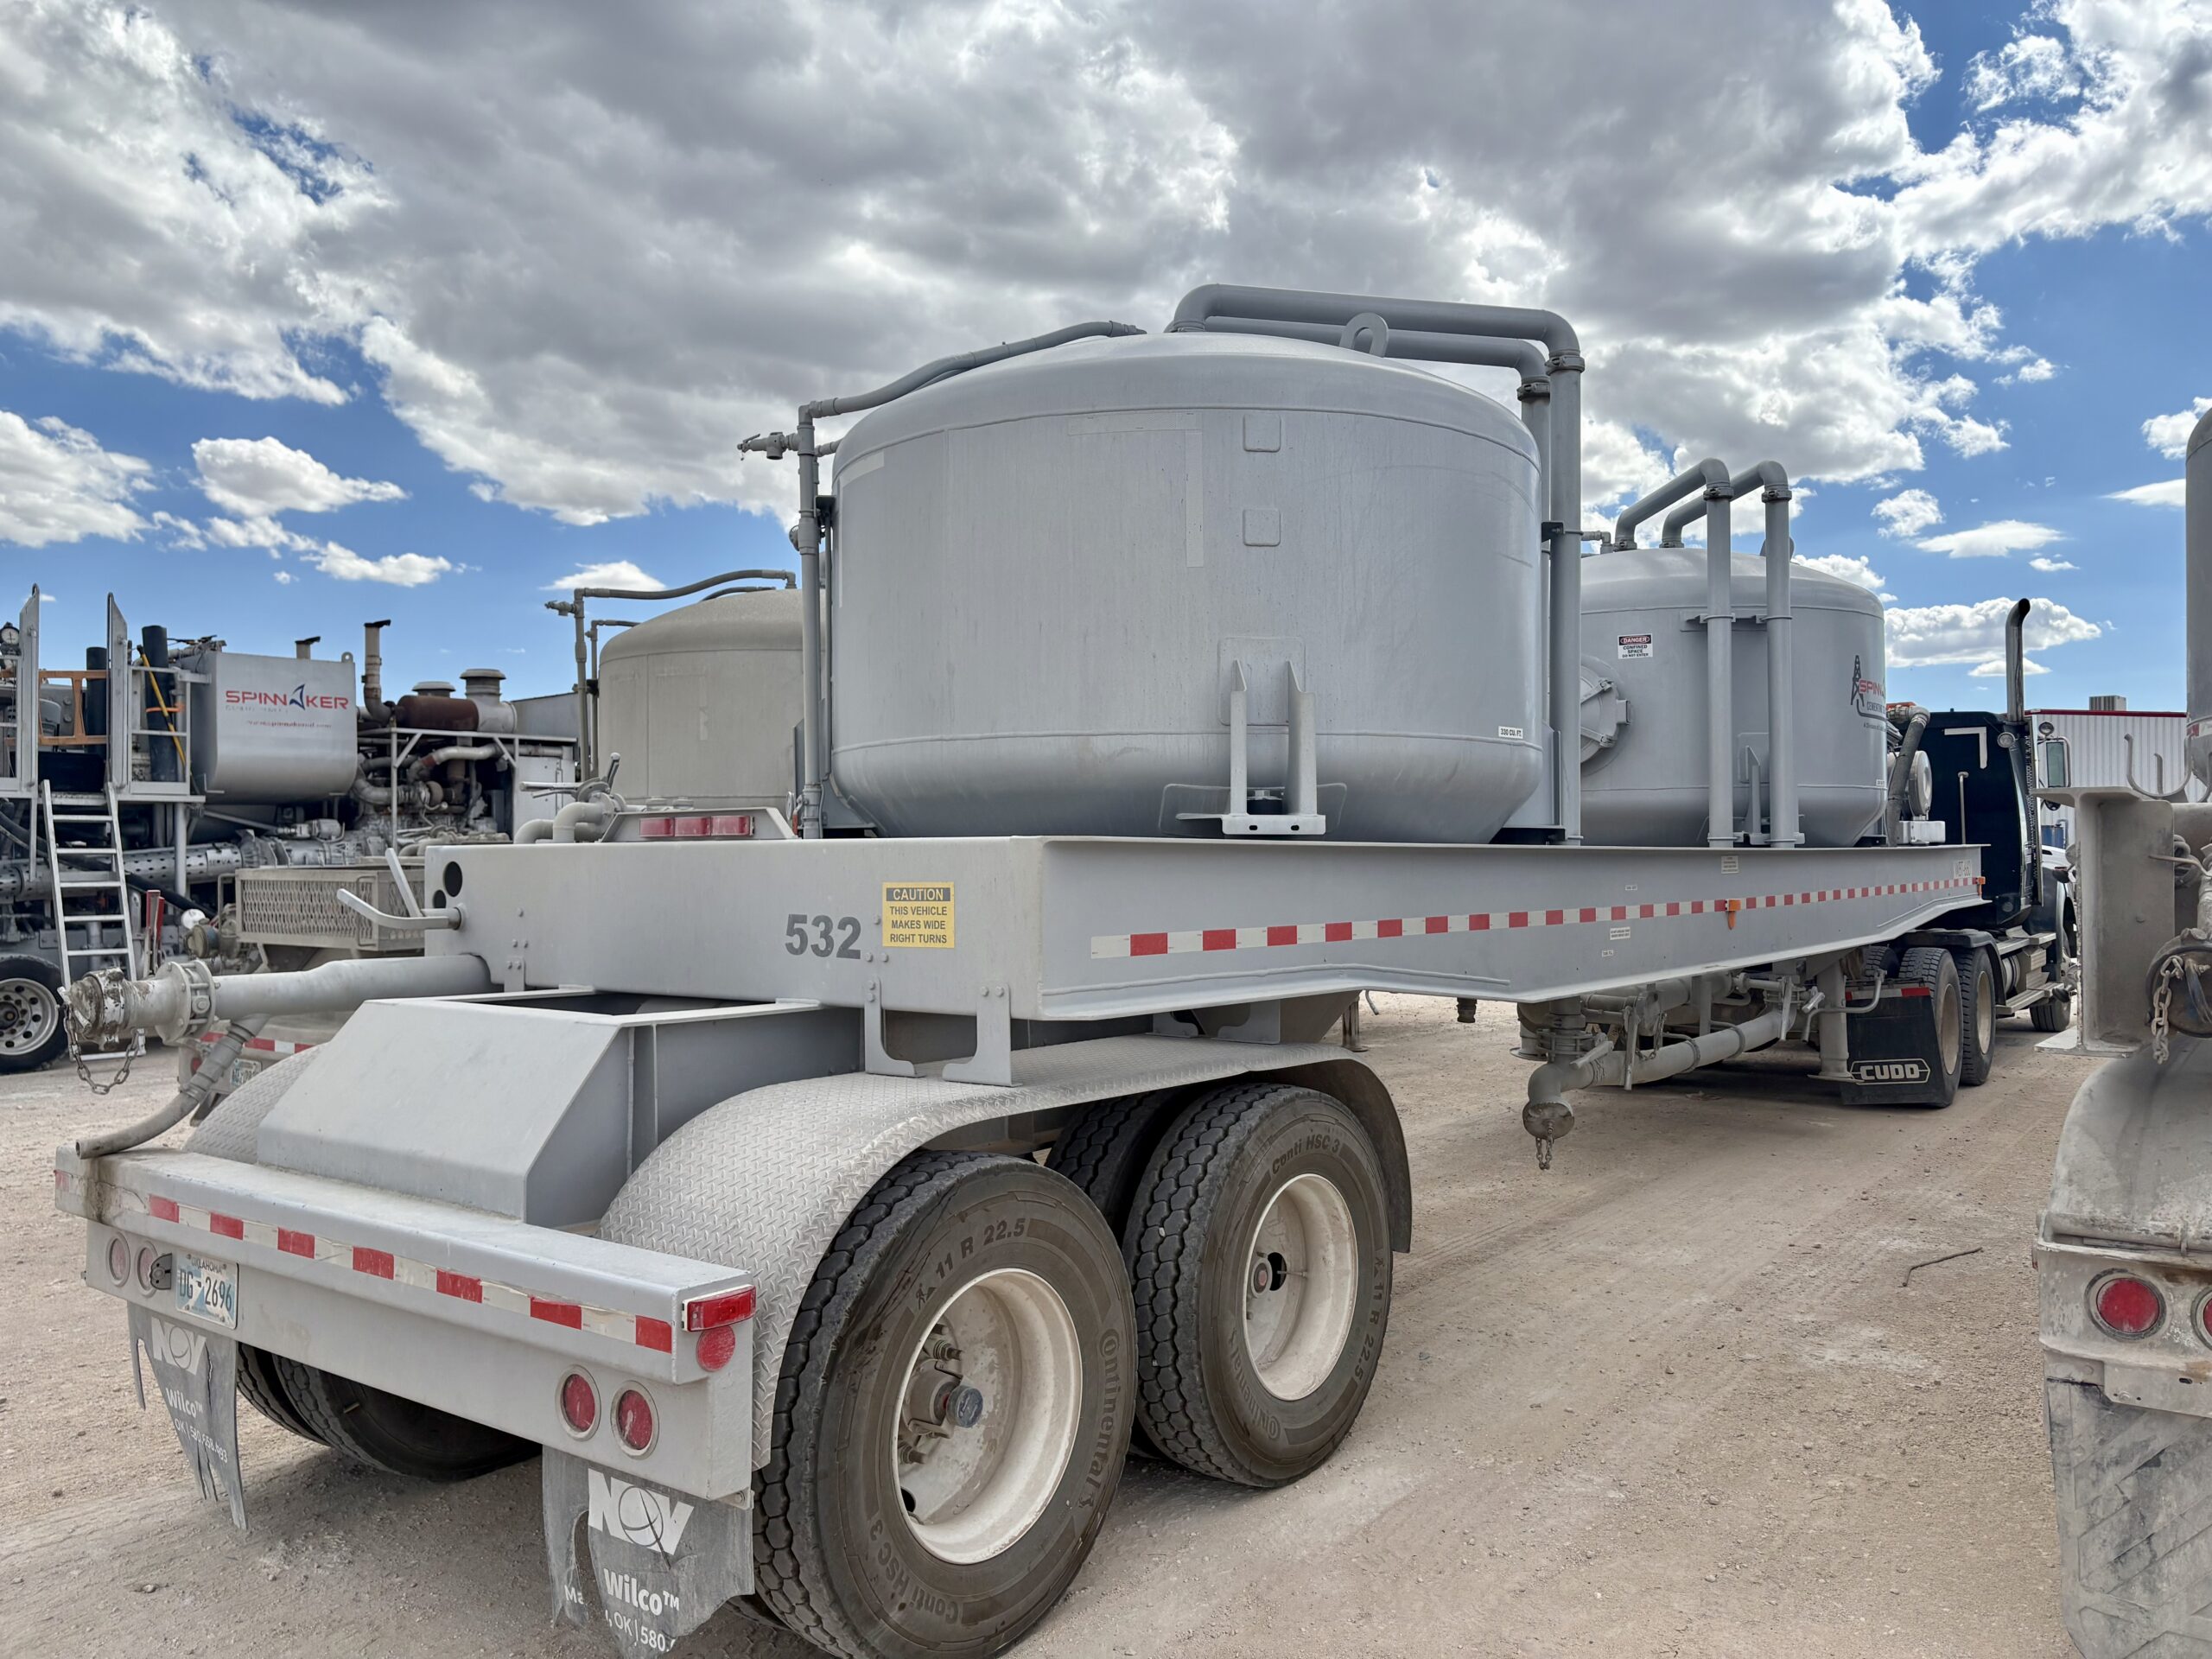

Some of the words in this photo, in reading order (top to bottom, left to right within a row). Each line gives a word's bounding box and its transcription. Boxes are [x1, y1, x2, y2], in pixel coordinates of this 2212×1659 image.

[226, 683, 349, 711] SPINNAKER
[893, 888, 944, 901] CAUTION
[890, 906, 909, 916] THIS
[911, 906, 948, 916] VEHICLE
[785, 913, 861, 960] 532
[891, 919, 922, 930] MAKES
[924, 920, 946, 930] WIDE
[890, 933, 916, 943] RIGHT
[918, 934, 948, 944] TURNS
[1859, 1064, 1920, 1080] CUDD
[1273, 1138, 1302, 1175] Conti
[1306, 1134, 1331, 1151] HSC
[1332, 1138, 1340, 1154] 3
[936, 1252, 954, 1279] 11
[960, 1236, 974, 1259] R
[983, 1217, 1027, 1246] 22.5
[191, 1256, 223, 1274] OKLAHOMA
[205, 1276, 232, 1312] 2696
[1372, 1282, 1384, 1300] 11
[1369, 1310, 1381, 1325] R
[150, 1316, 207, 1376] NOV
[1354, 1333, 1375, 1381] 22.5
[1085, 1328, 1121, 1488] Continental
[175, 1418, 187, 1435] OK
[588, 1467, 695, 1556] NOV
[869, 1518, 883, 1541] 3
[878, 1541, 911, 1598] HSC
[909, 1585, 959, 1624] Conti
[613, 1612, 633, 1637] OK
